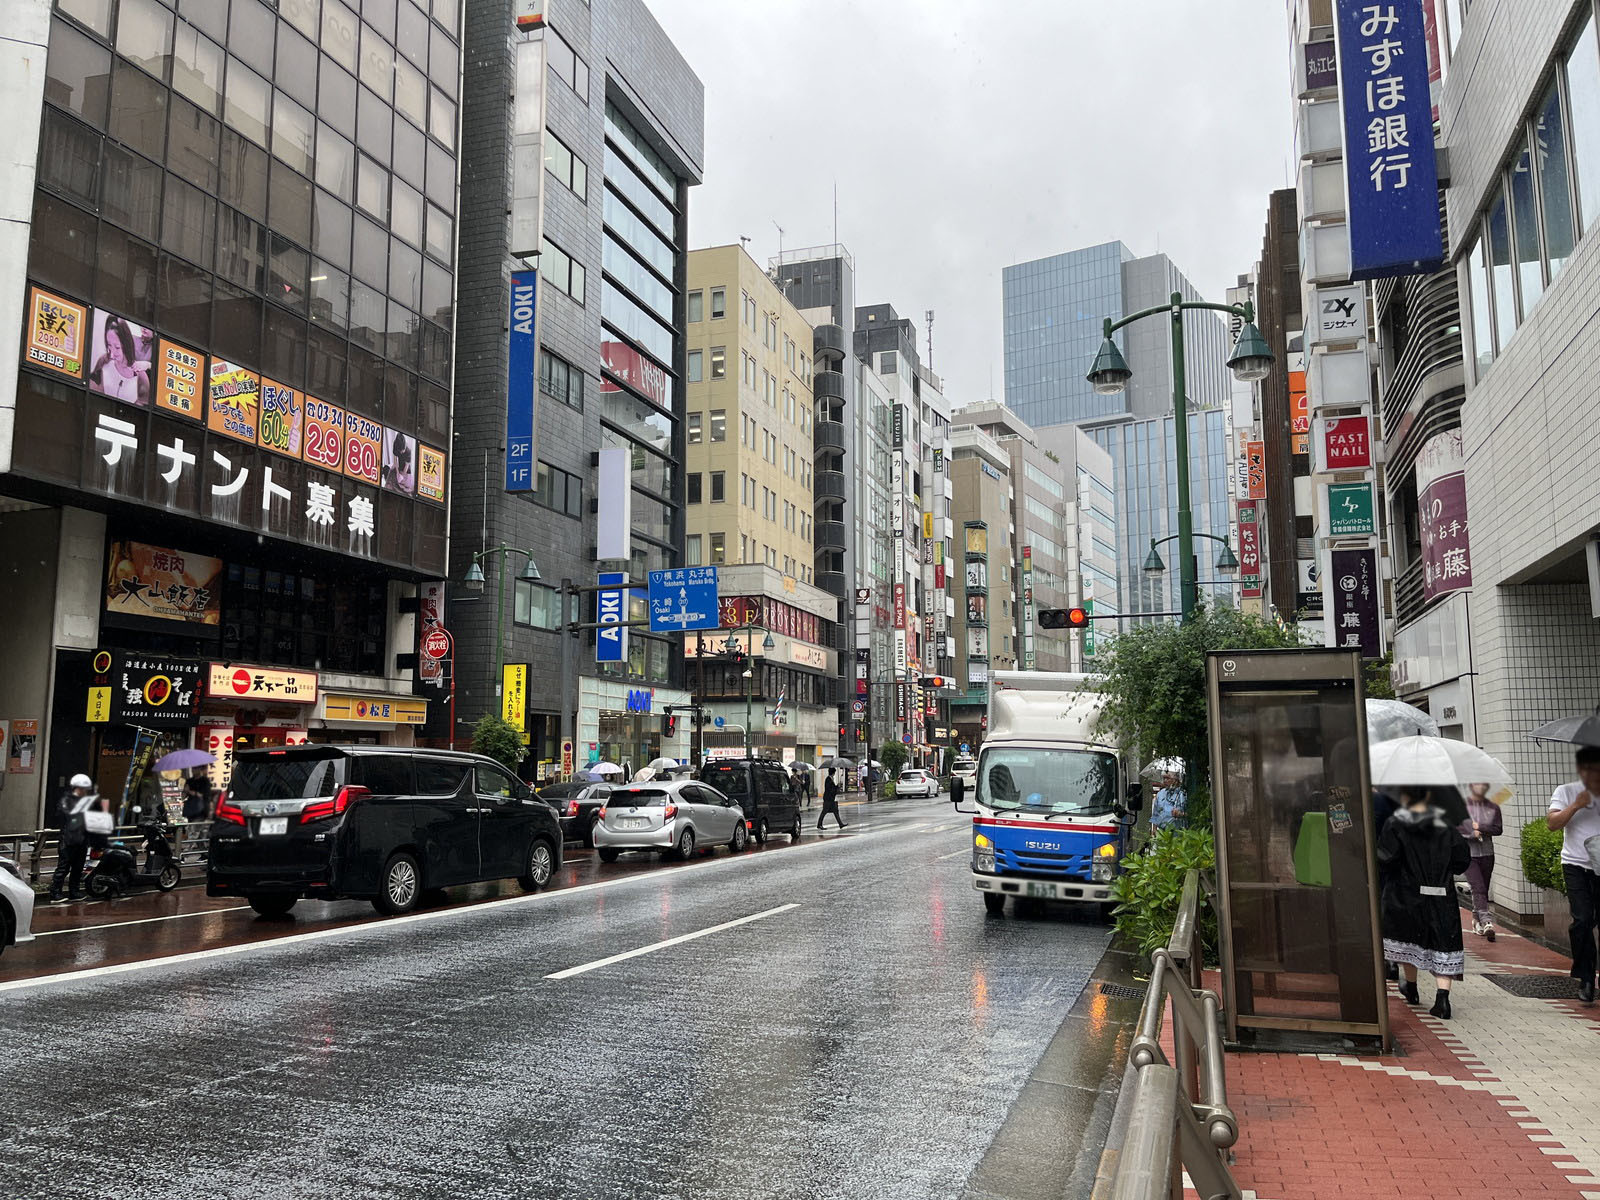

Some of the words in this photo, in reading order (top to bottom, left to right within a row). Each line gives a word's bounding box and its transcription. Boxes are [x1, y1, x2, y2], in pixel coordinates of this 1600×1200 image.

[1360, 4, 1412, 192] みずほ銀行
[514, 285, 533, 335] AOKI
[1322, 297, 1357, 318] ZXY
[1323, 319, 1358, 330] ジザイ
[29, 347, 65, 369] 五反田店
[166, 362, 197, 383] ストレス
[166, 377, 196, 397] 肩こり
[211, 399, 245, 423] いつでも
[262, 386, 300, 415] ほぐし
[223, 417, 255, 440] この価格
[1330, 432, 1364, 446] FAST
[511, 444, 529, 457] 2F
[1330, 445, 1365, 457] NAIL
[95, 413, 376, 538] テナント募集
[511, 469, 529, 482] 1F
[893, 460, 901, 524] カラオケ
[1242, 529, 1257, 567] なか卯
[152, 550, 185, 575] 焼肉
[664, 570, 685, 581] 横浜
[689, 568, 714, 579] 丸子橋
[652, 597, 673, 608] 大崎
[600, 591, 620, 642] AOKI
[428, 639, 447, 651] 消火栓
[253, 675, 298, 695] 天下一品
[370, 703, 390, 718] 松屋
[627, 688, 652, 713] AOKI
[1025, 840, 1061, 851] ISUZU
